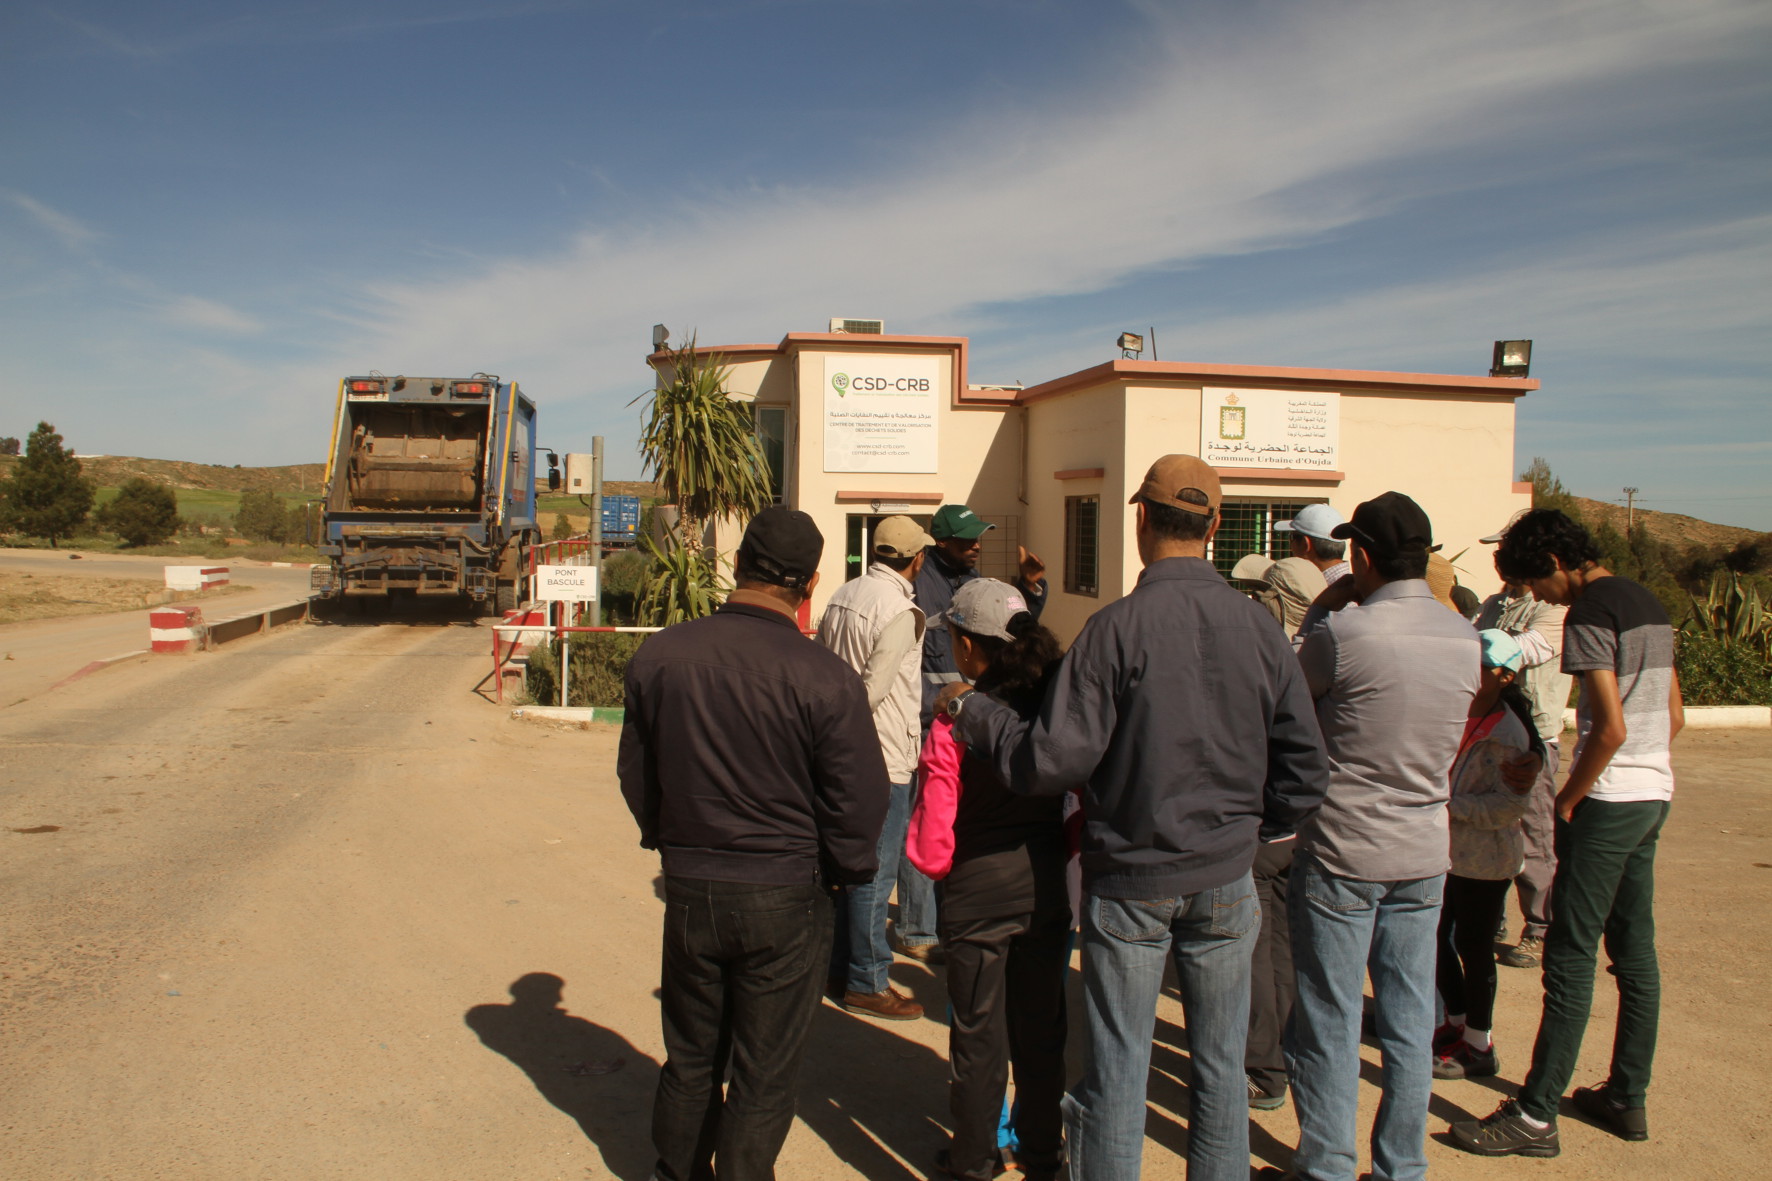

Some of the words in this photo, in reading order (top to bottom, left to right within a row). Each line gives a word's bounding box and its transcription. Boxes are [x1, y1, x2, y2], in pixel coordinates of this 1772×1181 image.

[852, 377, 930, 392] CSD-CRB
[1208, 441, 1242, 453] لوجدة
[1244, 441, 1290, 454] الحضرية
[1294, 443, 1333, 456] الجماعة
[1208, 454, 1255, 463] Commune
[1257, 456, 1294, 464] Urbaine
[1295, 457, 1332, 466] d'Oujda
[547, 578, 585, 586] BASCULE
